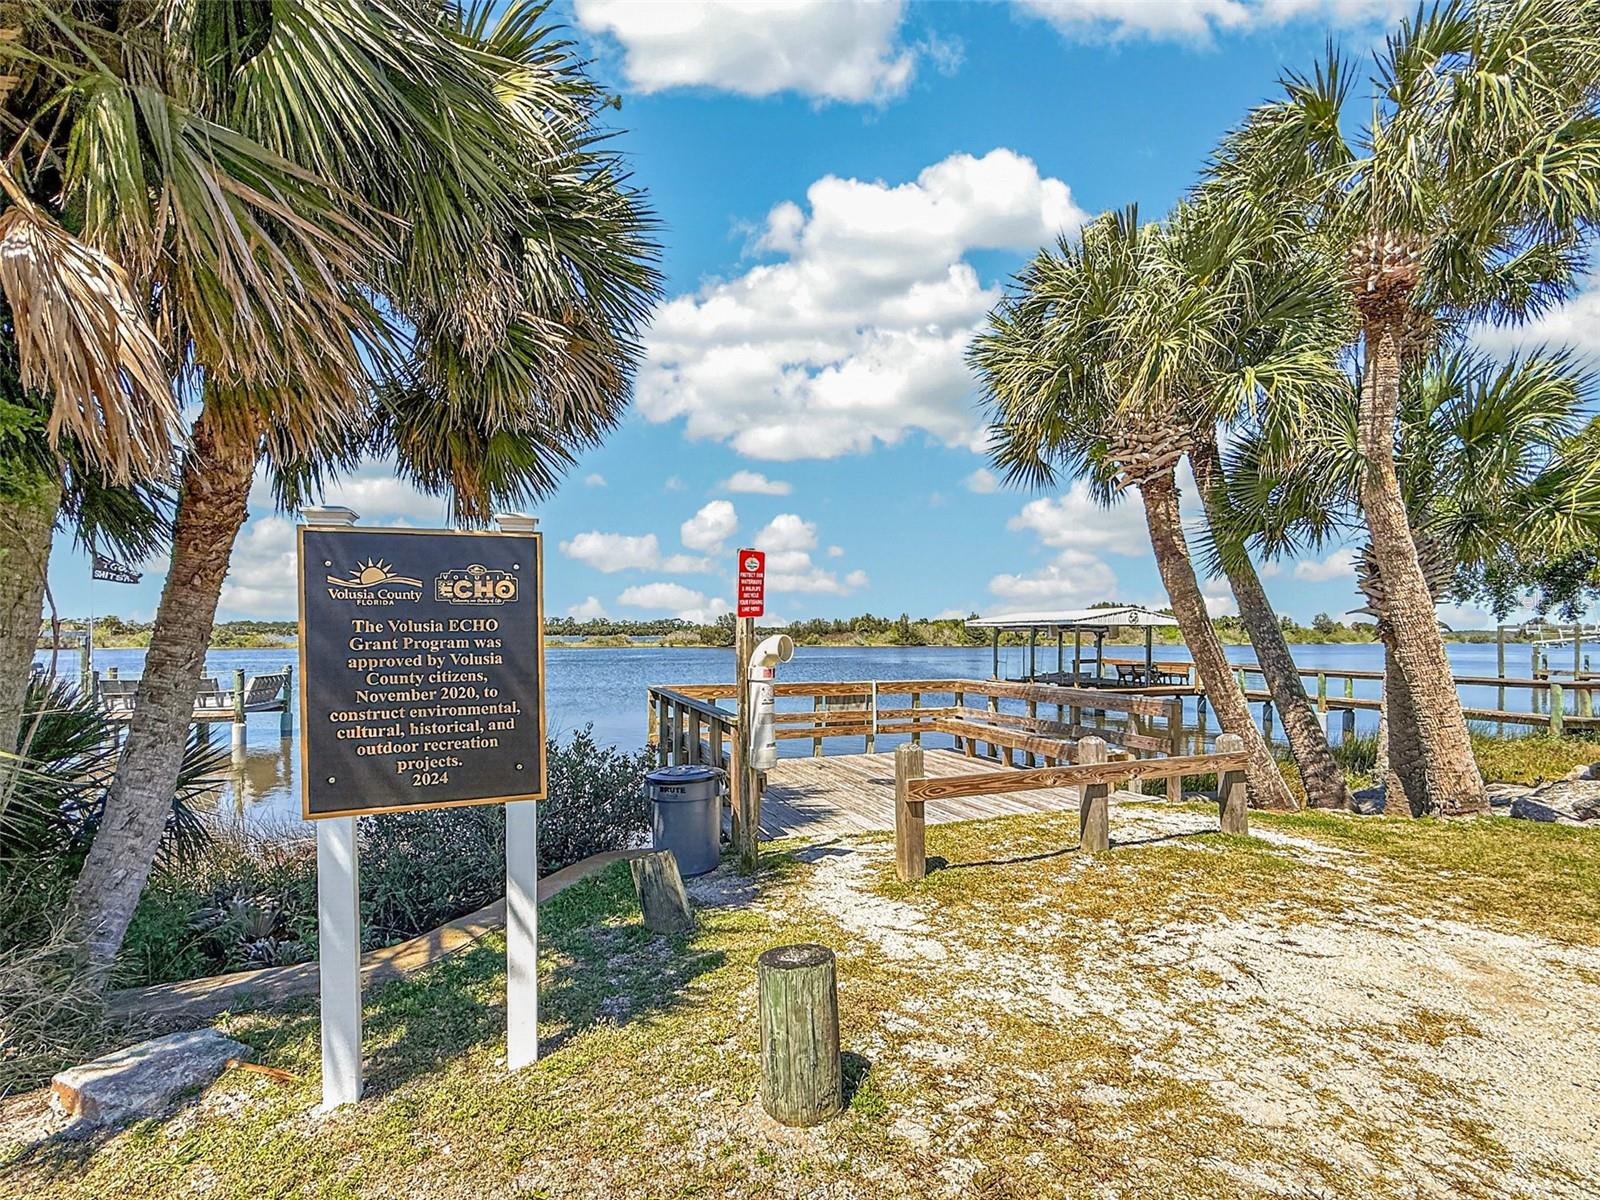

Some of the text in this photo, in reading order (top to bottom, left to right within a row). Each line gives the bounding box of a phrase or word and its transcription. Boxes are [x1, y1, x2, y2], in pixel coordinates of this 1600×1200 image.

[328, 588, 423, 603] Volusia County
[438, 580, 516, 599] ECHO
[351, 618, 499, 633] The Volusia ECHO
[349, 635, 502, 652] Grant Program was
[348, 652, 503, 671] approved by Volusia
[366, 670, 488, 687] County citizens,
[355, 686, 499, 703] November 2020, to
[329, 701, 521, 722] construct environmental,
[336, 718, 515, 739] cultural, historical, and
[356, 736, 499, 756] outdoor recreation
[396, 755, 463, 774] projects.
[412, 771, 449, 787] 2024
